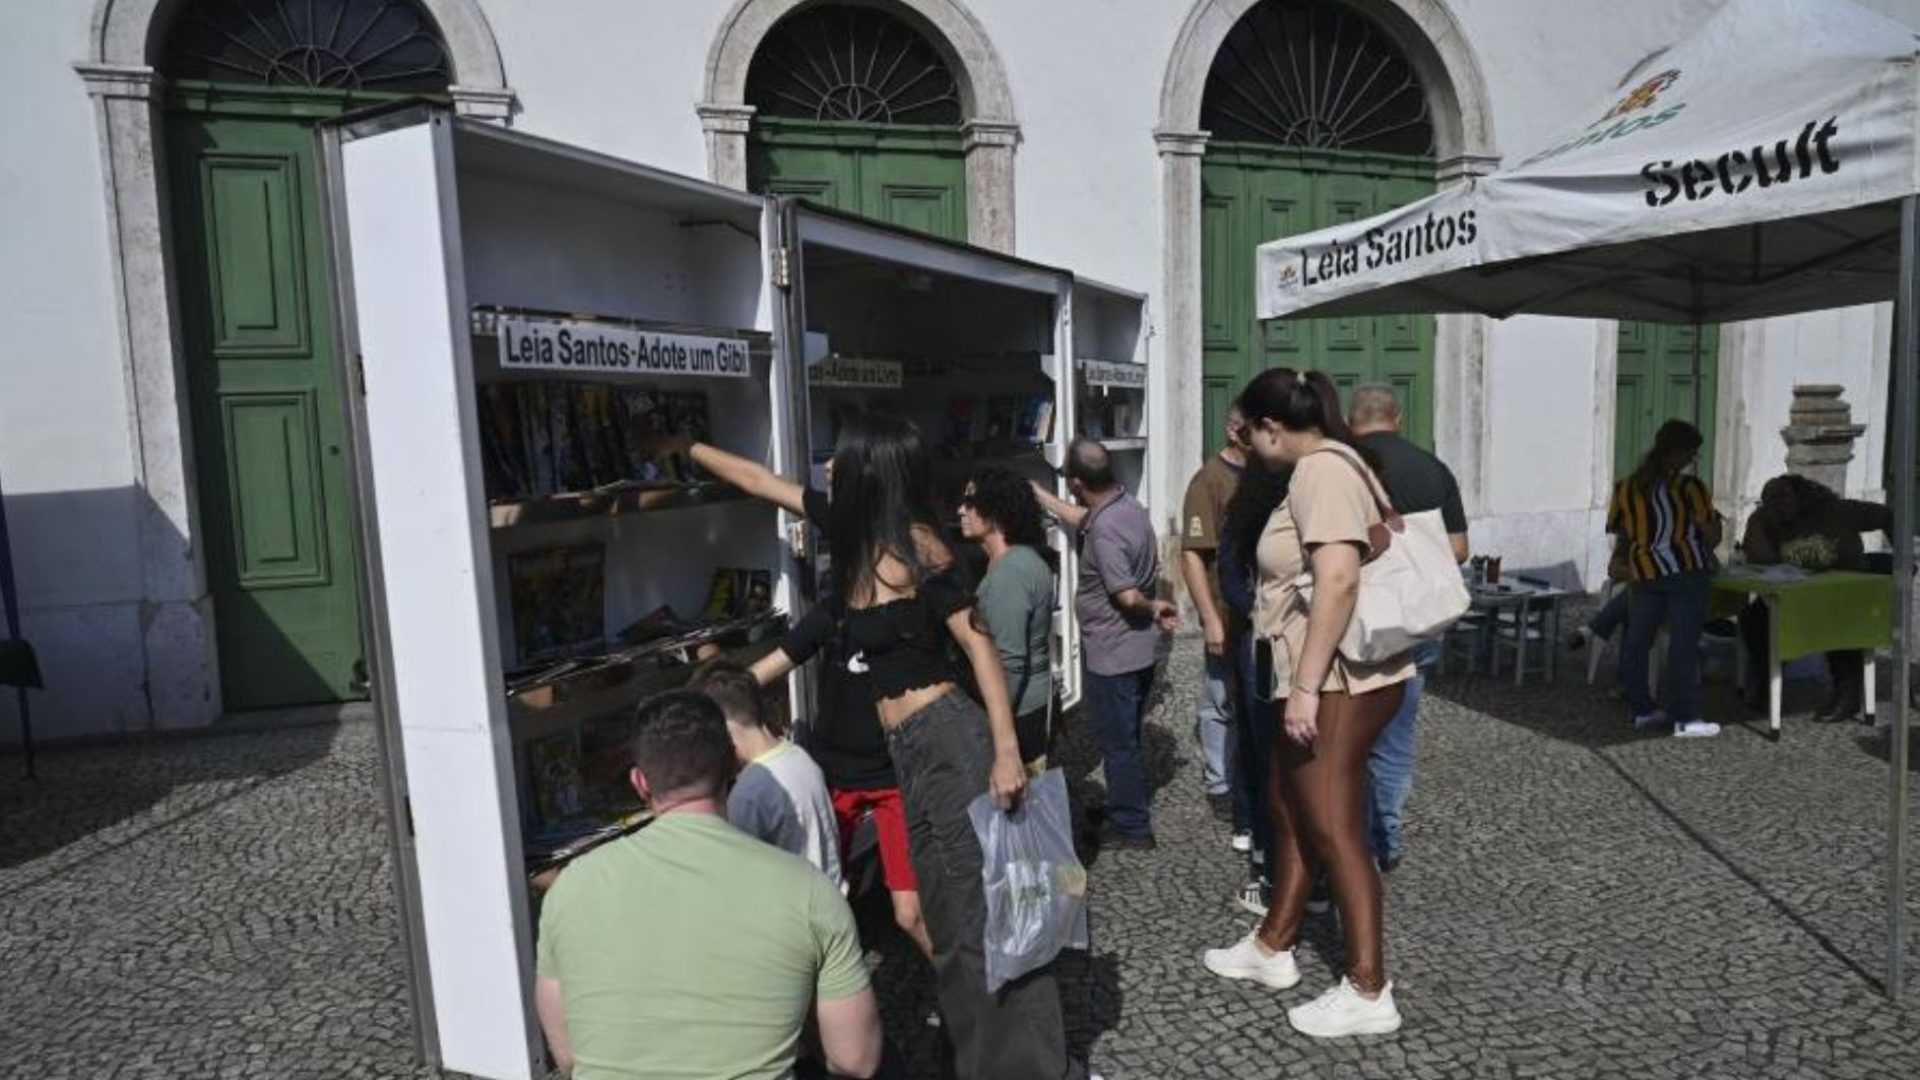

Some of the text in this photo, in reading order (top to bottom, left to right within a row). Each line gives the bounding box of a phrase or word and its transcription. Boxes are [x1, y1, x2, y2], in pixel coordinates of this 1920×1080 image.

[1641, 116, 1839, 207] Secult
[1301, 209, 1477, 286] Leia Santos
[506, 325, 747, 373] Leia Santos-Adote um Gibi
